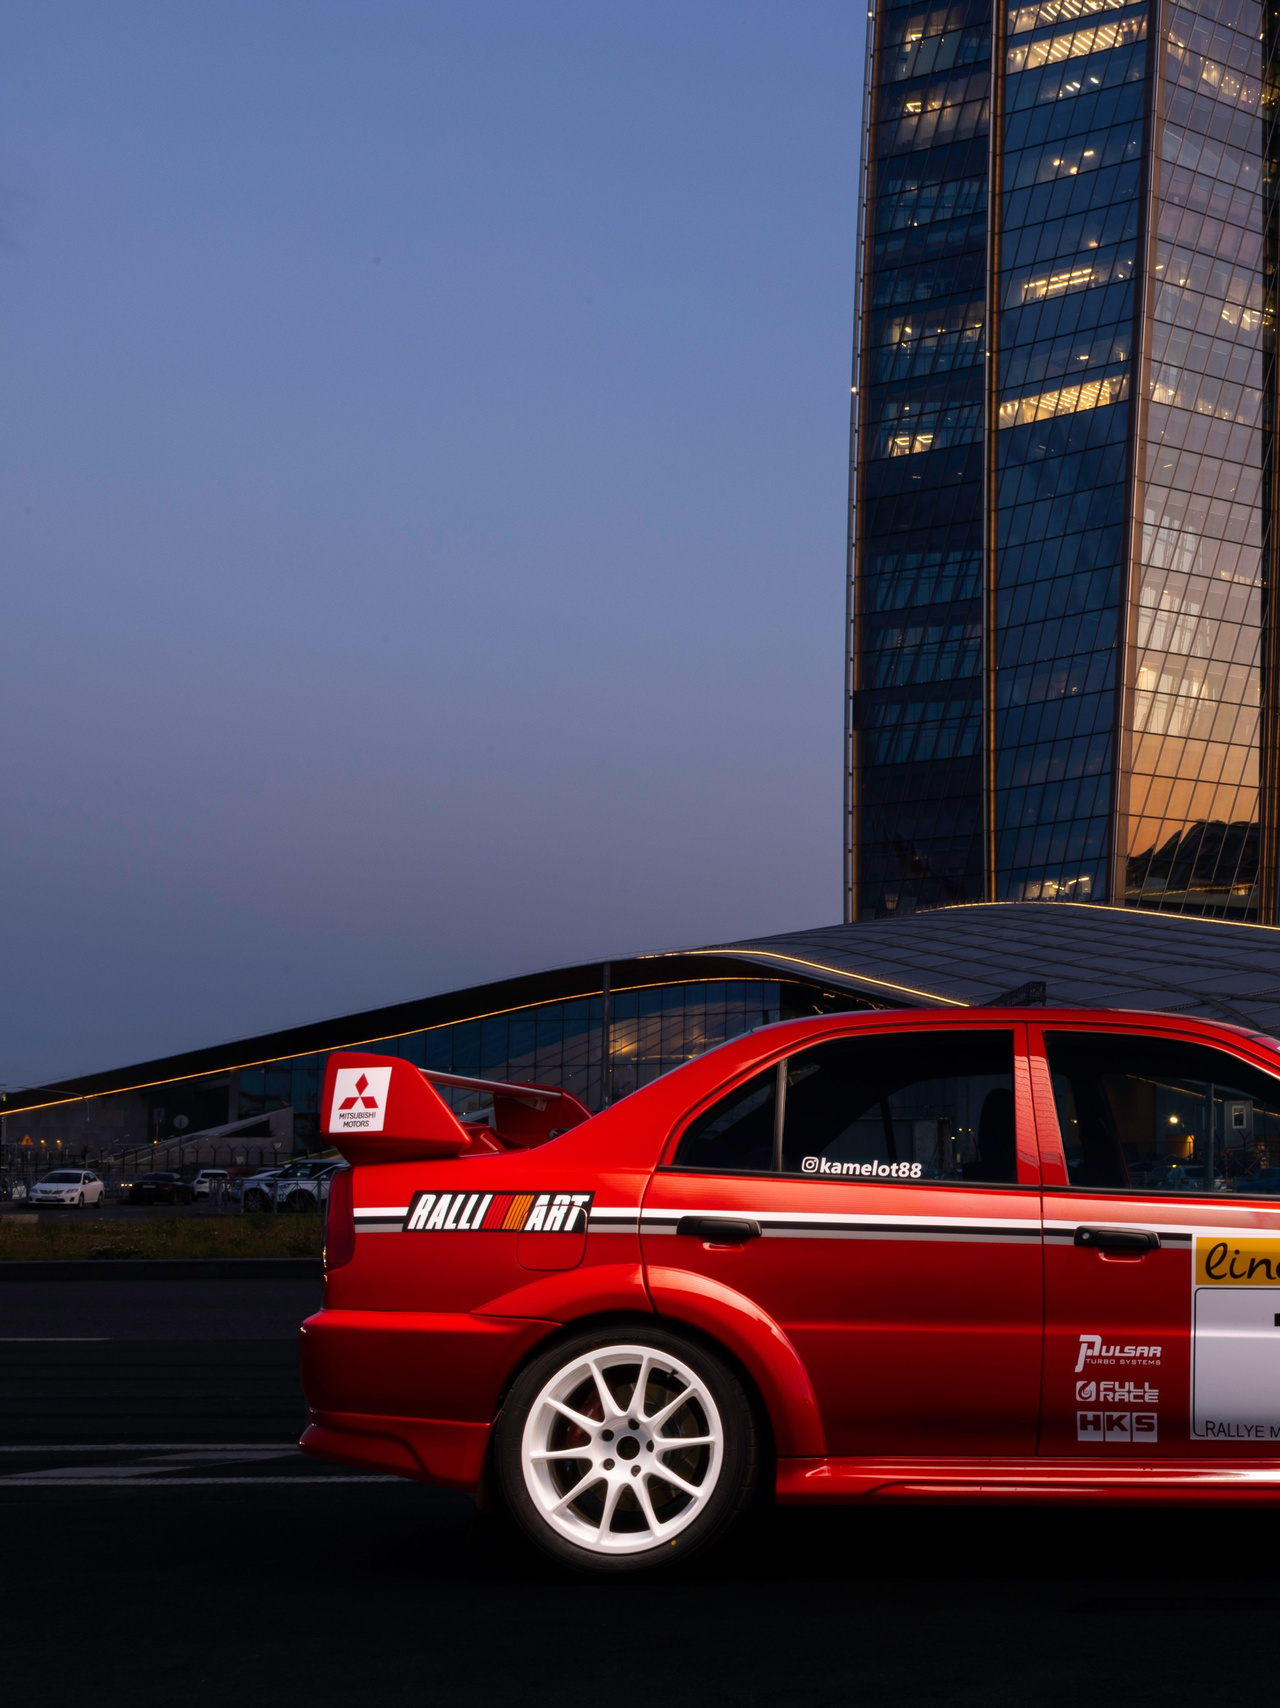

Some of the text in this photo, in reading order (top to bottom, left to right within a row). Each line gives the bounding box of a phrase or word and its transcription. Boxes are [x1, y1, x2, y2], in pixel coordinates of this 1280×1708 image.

[338, 1111, 376, 1120] MITSUBISHI
[342, 1120, 370, 1128] MOTORS
[819, 1157, 923, 1179] kamelot88
[407, 1194, 591, 1231] RALLI ART
[1074, 1334, 1162, 1373] PULSAR
[1099, 1381, 1159, 1393] FULL
[1099, 1391, 1159, 1403] RACE
[1078, 1412, 1157, 1436] HKS
[1205, 1420, 1265, 1438] RALLYE
